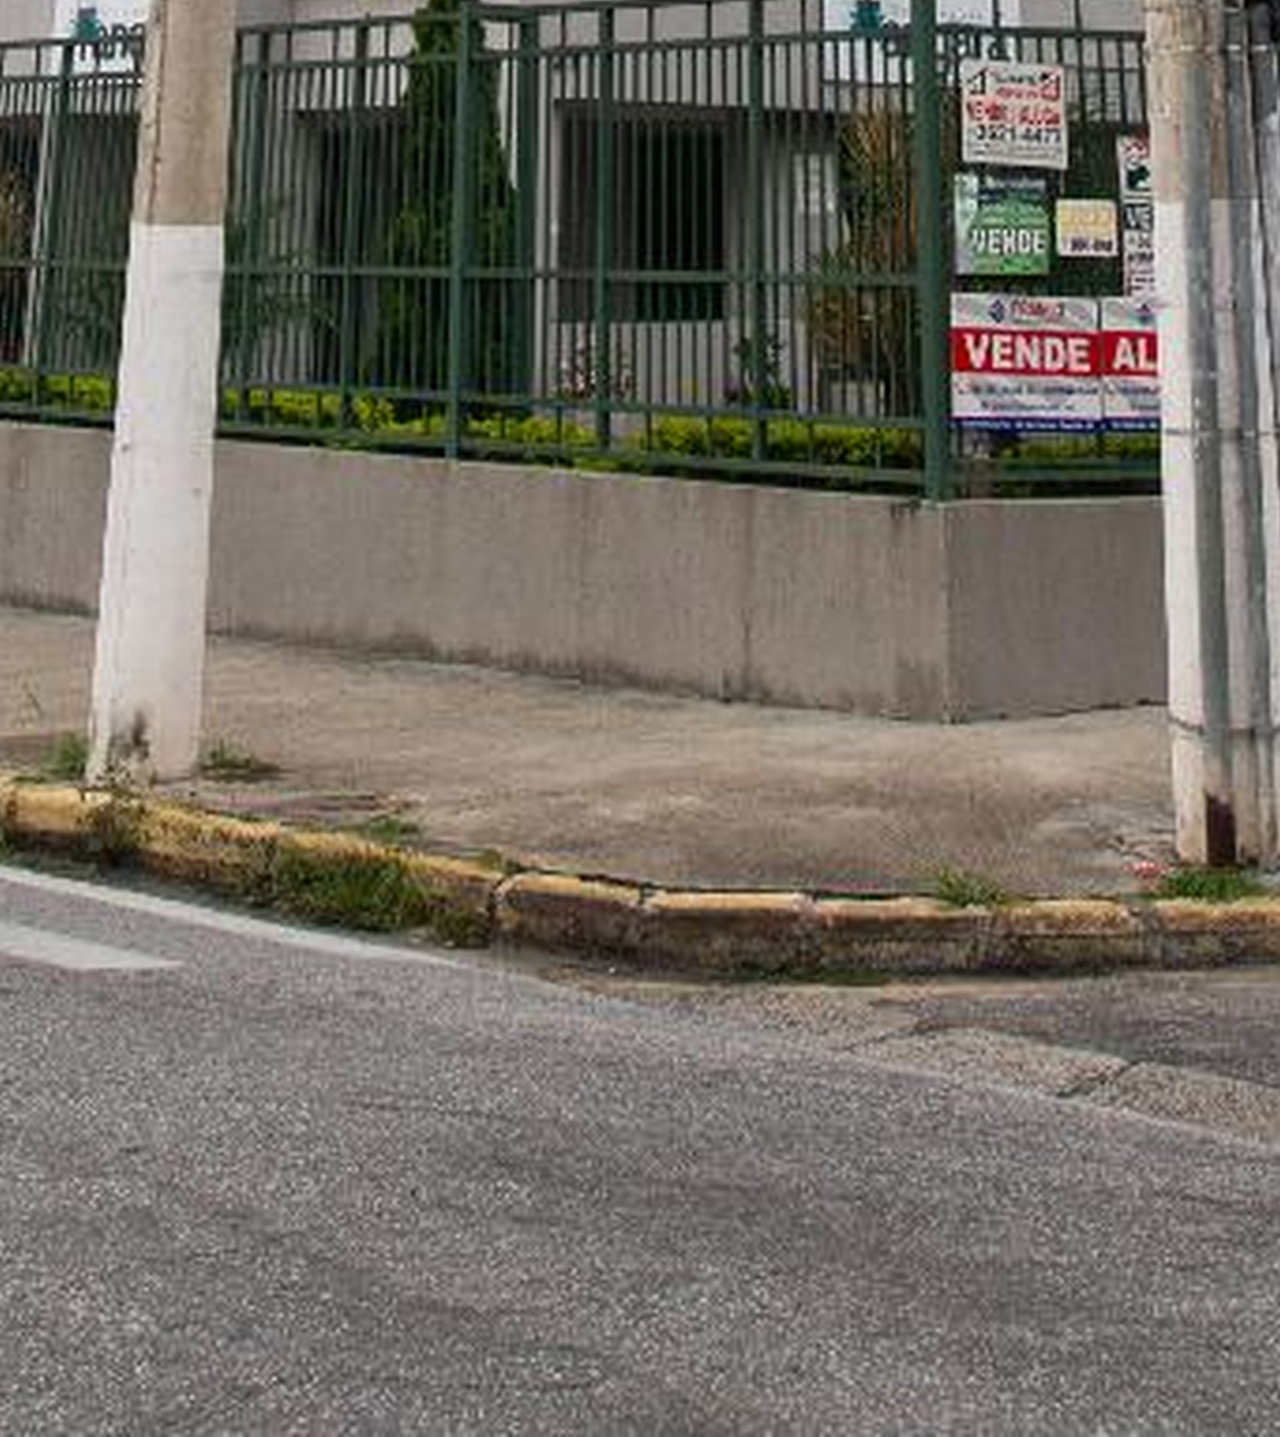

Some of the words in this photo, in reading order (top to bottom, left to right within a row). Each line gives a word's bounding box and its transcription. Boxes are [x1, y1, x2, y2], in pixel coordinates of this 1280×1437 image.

[972, 228, 1046, 255] VENDE
[964, 333, 1091, 373] VENDE
[1112, 337, 1158, 371] AL
